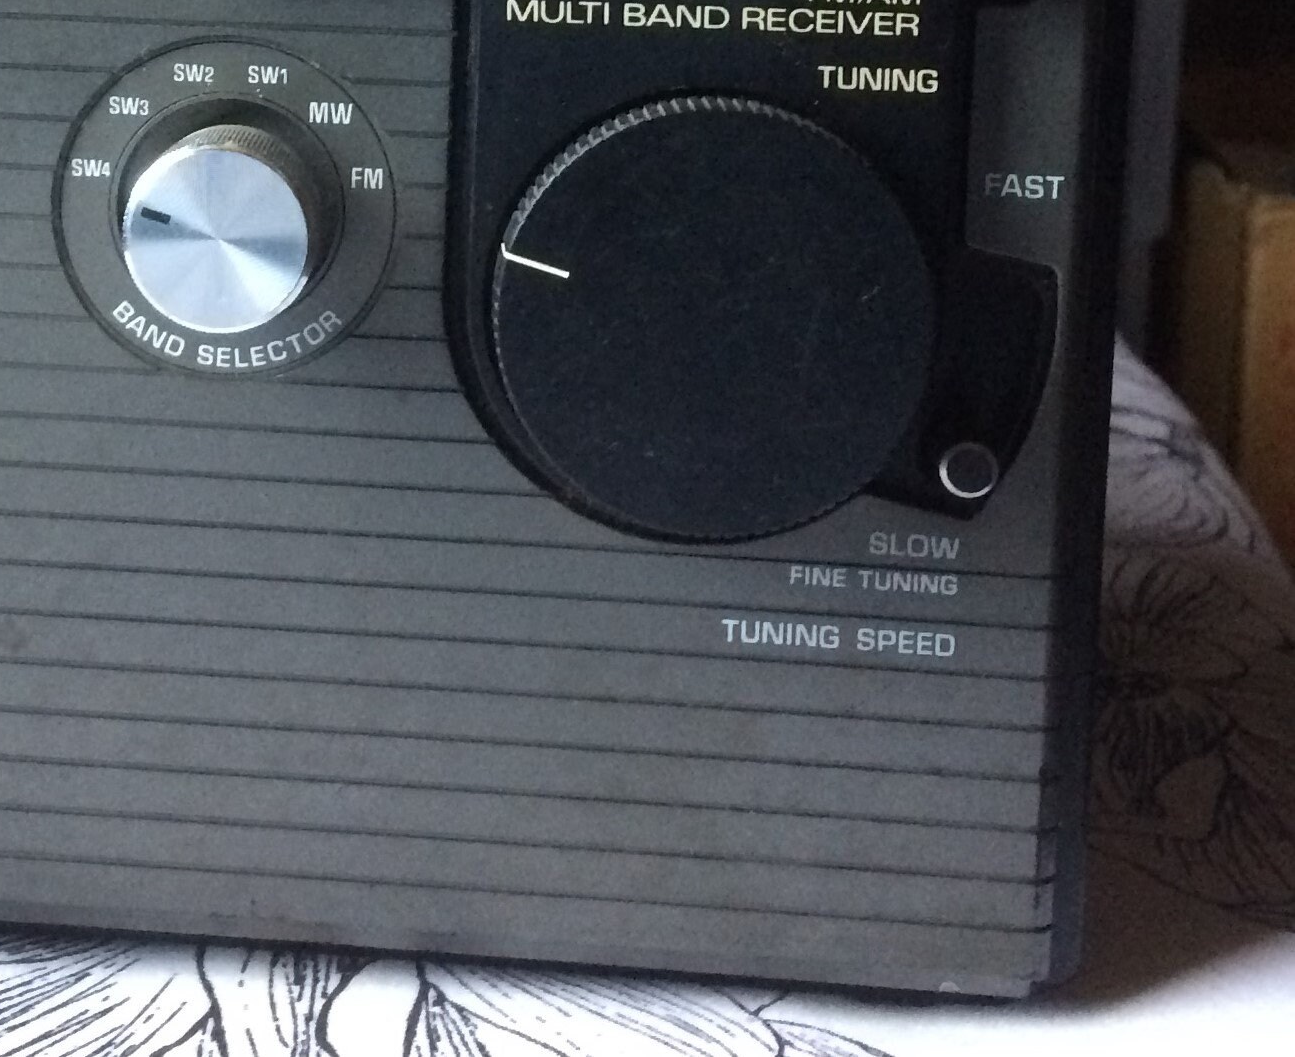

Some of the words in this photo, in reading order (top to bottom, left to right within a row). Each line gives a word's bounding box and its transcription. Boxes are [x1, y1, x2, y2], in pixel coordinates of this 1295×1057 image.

[506, 0, 610, 26] MULTI
[623, 3, 730, 29] BAND
[742, 8, 920, 37] RECEIVER
[174, 64, 215, 83] SW2
[248, 66, 288, 85] SW1
[818, 66, 939, 94] TUNING
[109, 97, 149, 116] SW3
[309, 102, 353, 125] MW
[71, 159, 111, 177] SW4
[351, 168, 384, 190] FM
[985, 173, 1065, 200] FAST
[113, 300, 186, 357] BAND
[196, 310, 342, 368] SELECTOR
[869, 532, 959, 560] SLOW
[789, 566, 847, 588] FINE
[858, 570, 958, 595] TUNING
[722, 619, 840, 649] TUNING
[856, 628, 955, 657] SPEED
